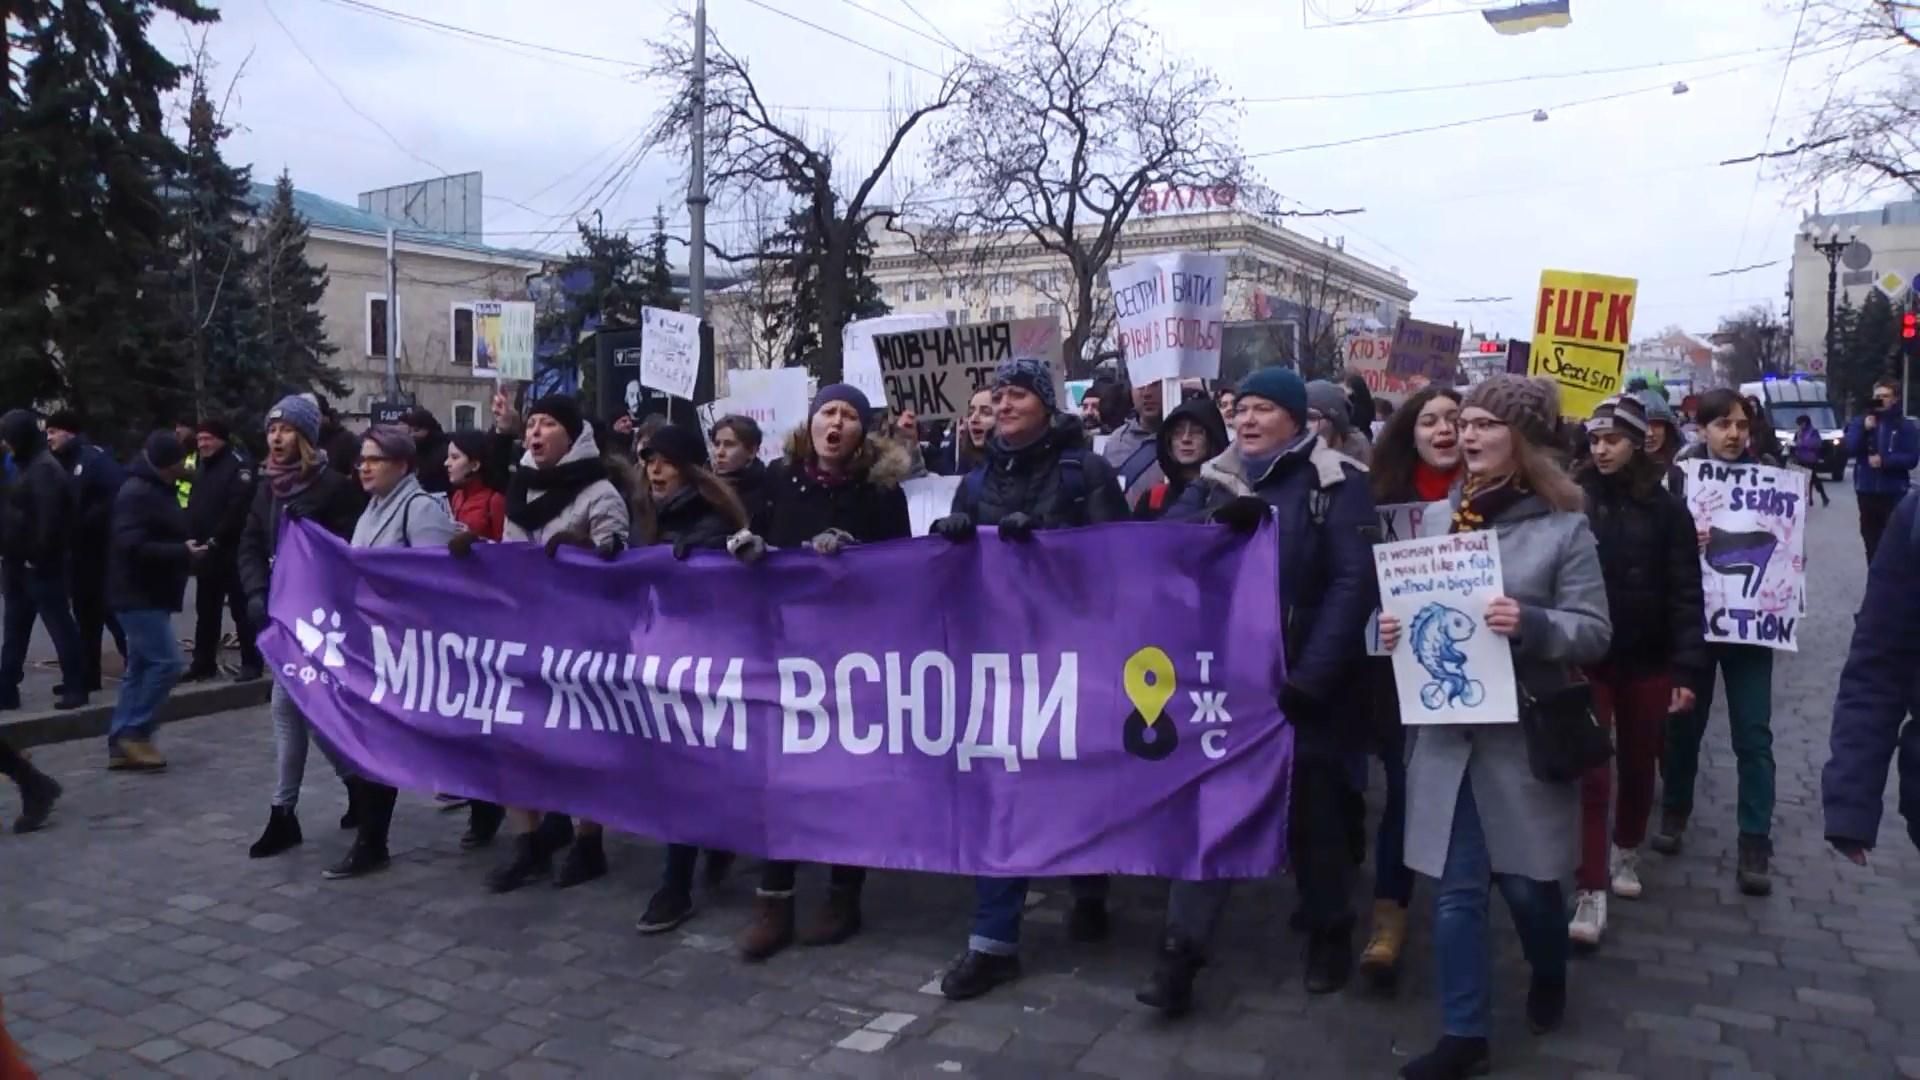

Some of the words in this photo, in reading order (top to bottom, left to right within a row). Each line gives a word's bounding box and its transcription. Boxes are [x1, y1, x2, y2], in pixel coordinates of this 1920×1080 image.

[1537, 287, 1633, 344] FUCK
[874, 323, 1012, 372] МОВЧАННЯ
[1543, 347, 1615, 391] Sexism
[883, 372, 956, 417] ЗНАК
[369, 624, 527, 734] МІСЦЕ
[540, 645, 747, 752] ЖІНКИ
[778, 650, 1078, 772] ВСЮДИ
